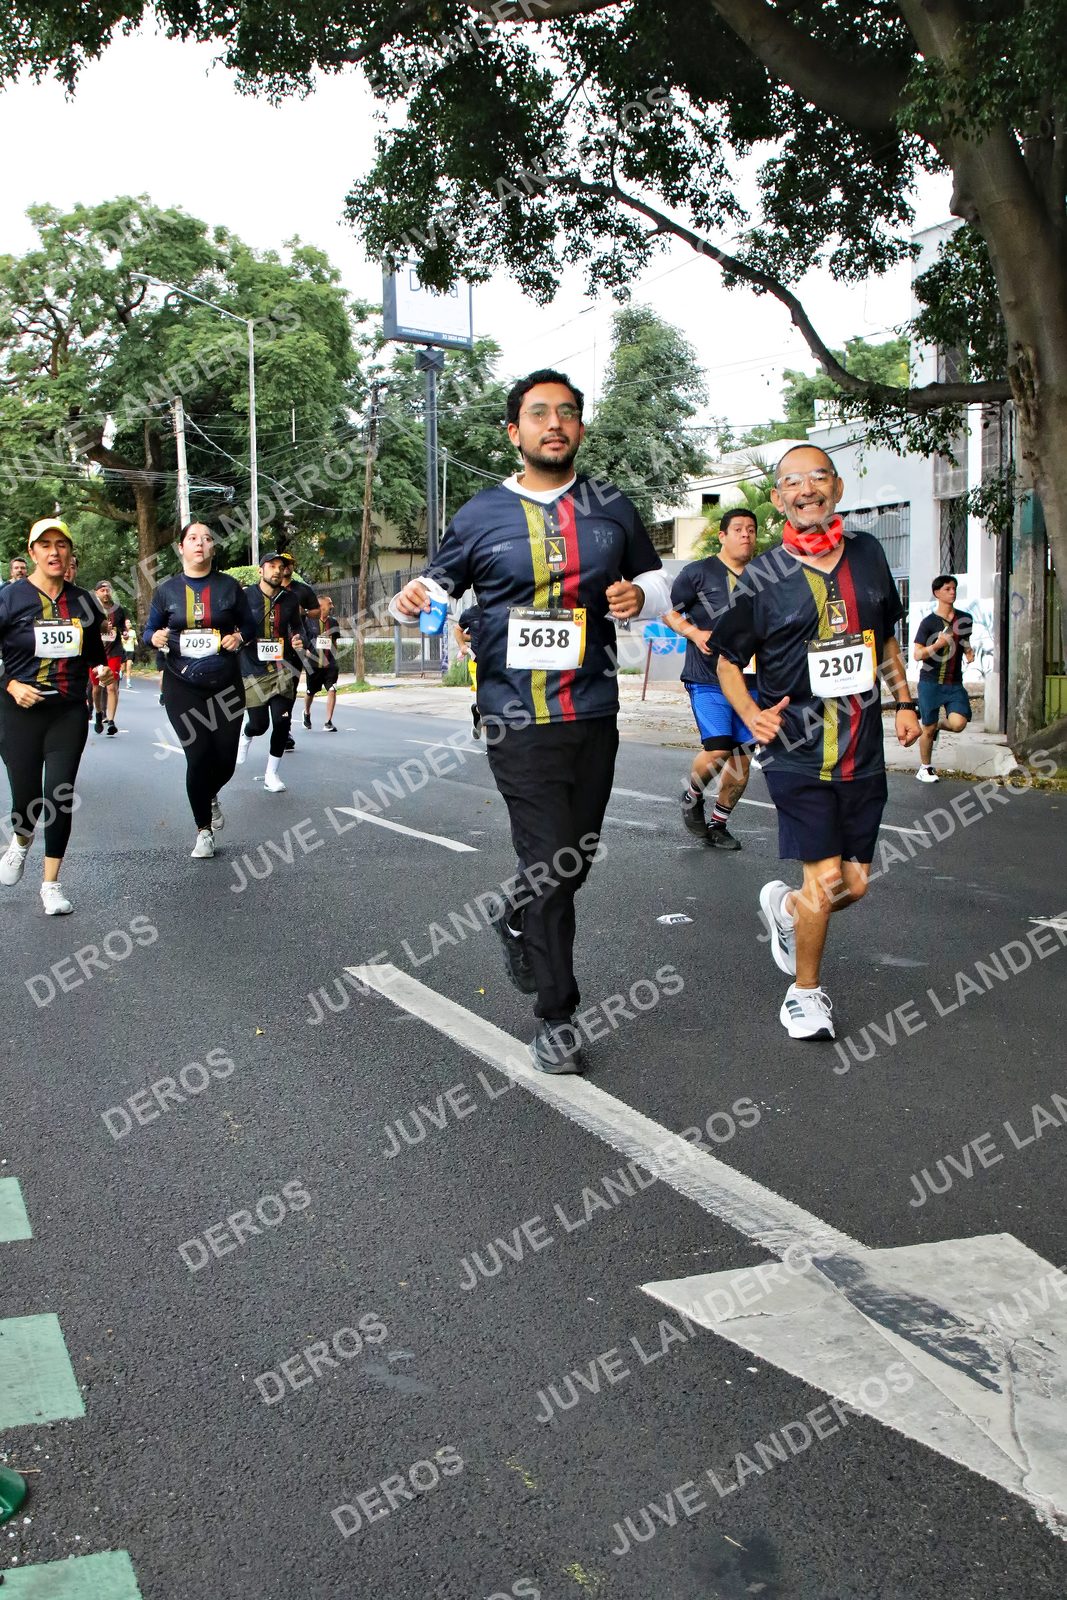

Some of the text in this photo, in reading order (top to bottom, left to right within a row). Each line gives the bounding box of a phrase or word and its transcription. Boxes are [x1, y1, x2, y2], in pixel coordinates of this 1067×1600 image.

[42, 631, 73, 644] 3505
[186, 639, 211, 648] 7095
[519, 628, 570, 648] 5638
[819, 653, 863, 678] 2307
